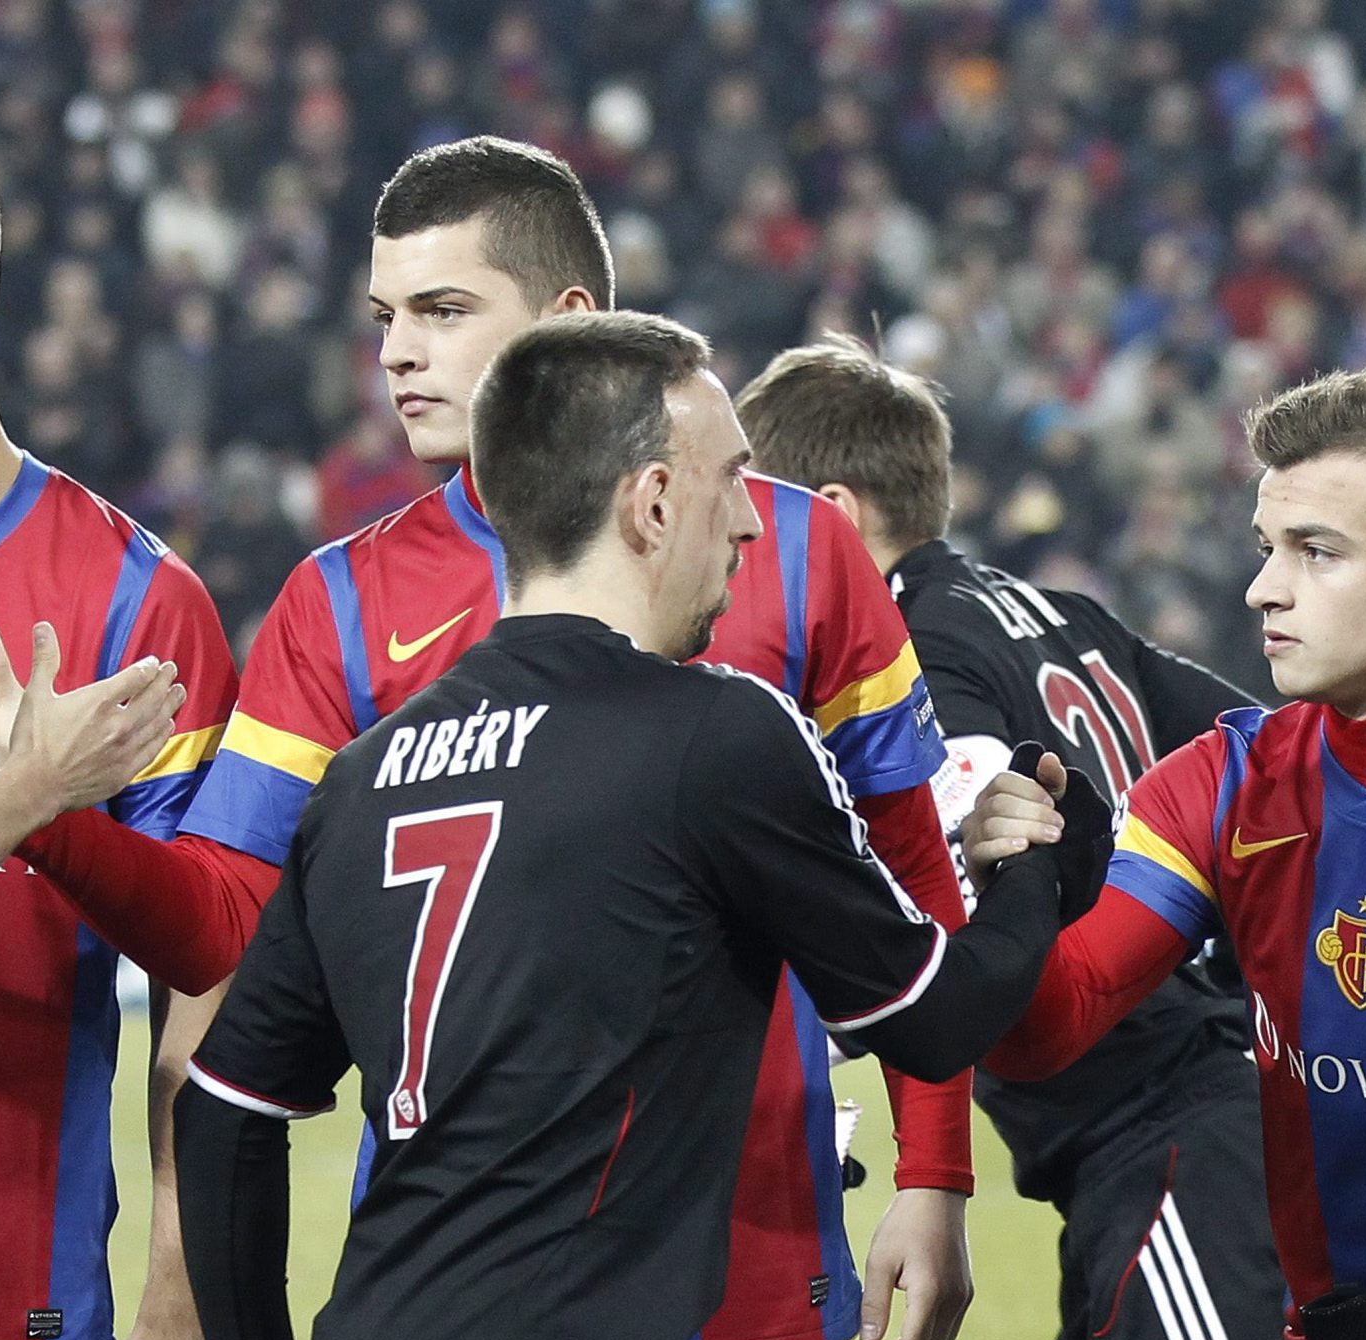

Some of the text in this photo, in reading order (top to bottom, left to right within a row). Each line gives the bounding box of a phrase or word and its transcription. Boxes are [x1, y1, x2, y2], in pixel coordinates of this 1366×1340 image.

[373, 698, 550, 790] RIBÉRY
[1037, 648, 1157, 804] 21
[381, 800, 504, 1141] 7
